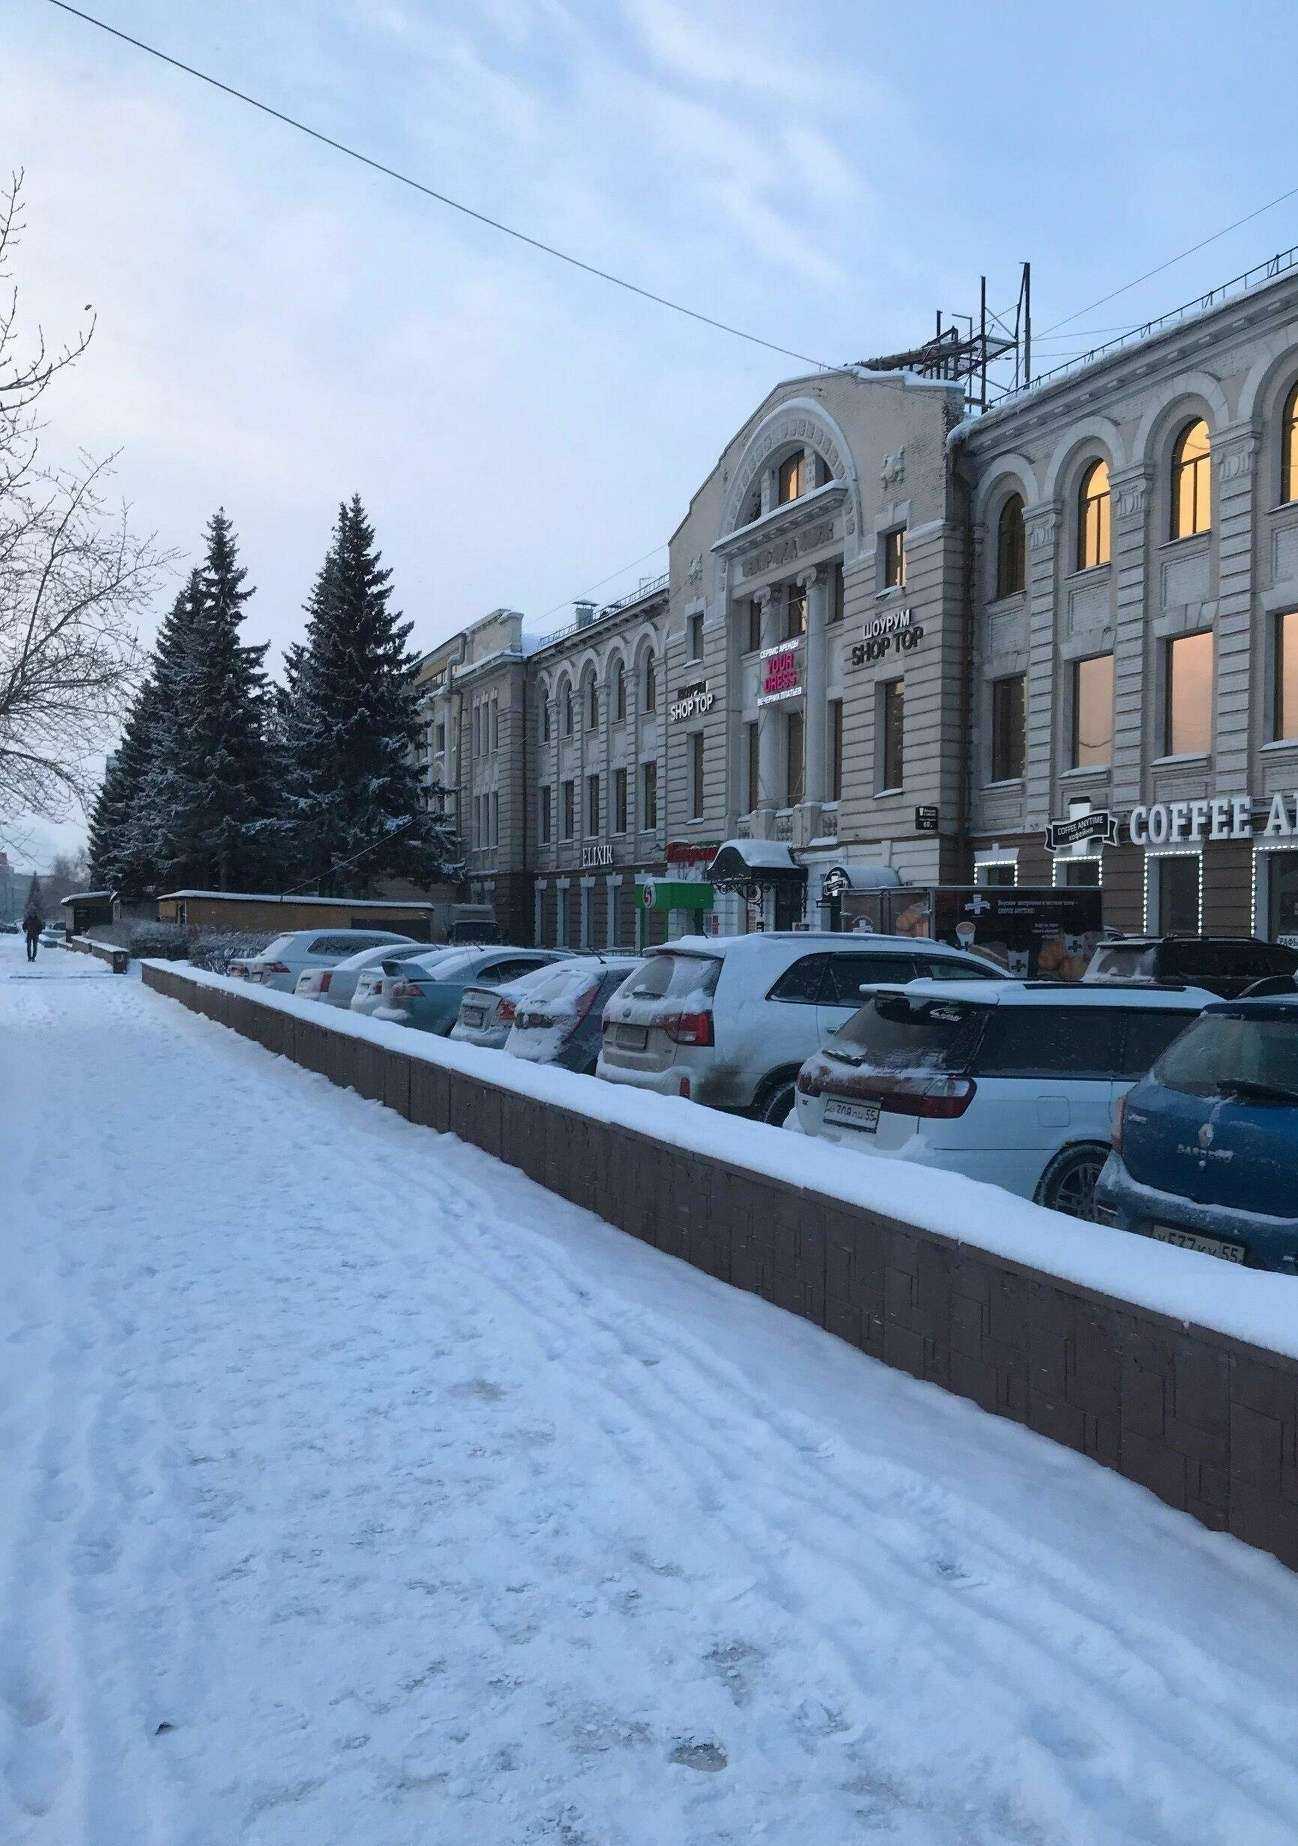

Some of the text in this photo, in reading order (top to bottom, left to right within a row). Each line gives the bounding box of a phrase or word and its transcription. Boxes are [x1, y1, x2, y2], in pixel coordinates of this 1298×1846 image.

[863, 609, 910, 640] ШОУРУМ
[851, 627, 923, 666] SHOP TOP
[767, 653, 795, 674] YOUR
[763, 671, 799, 694] DRESS
[670, 693, 713, 721] SHOP TOP
[1057, 816, 1104, 836] COFFEE ANYTIME
[1129, 791, 1298, 846] COFFEE A
[582, 845, 613, 867] ELIXIR
